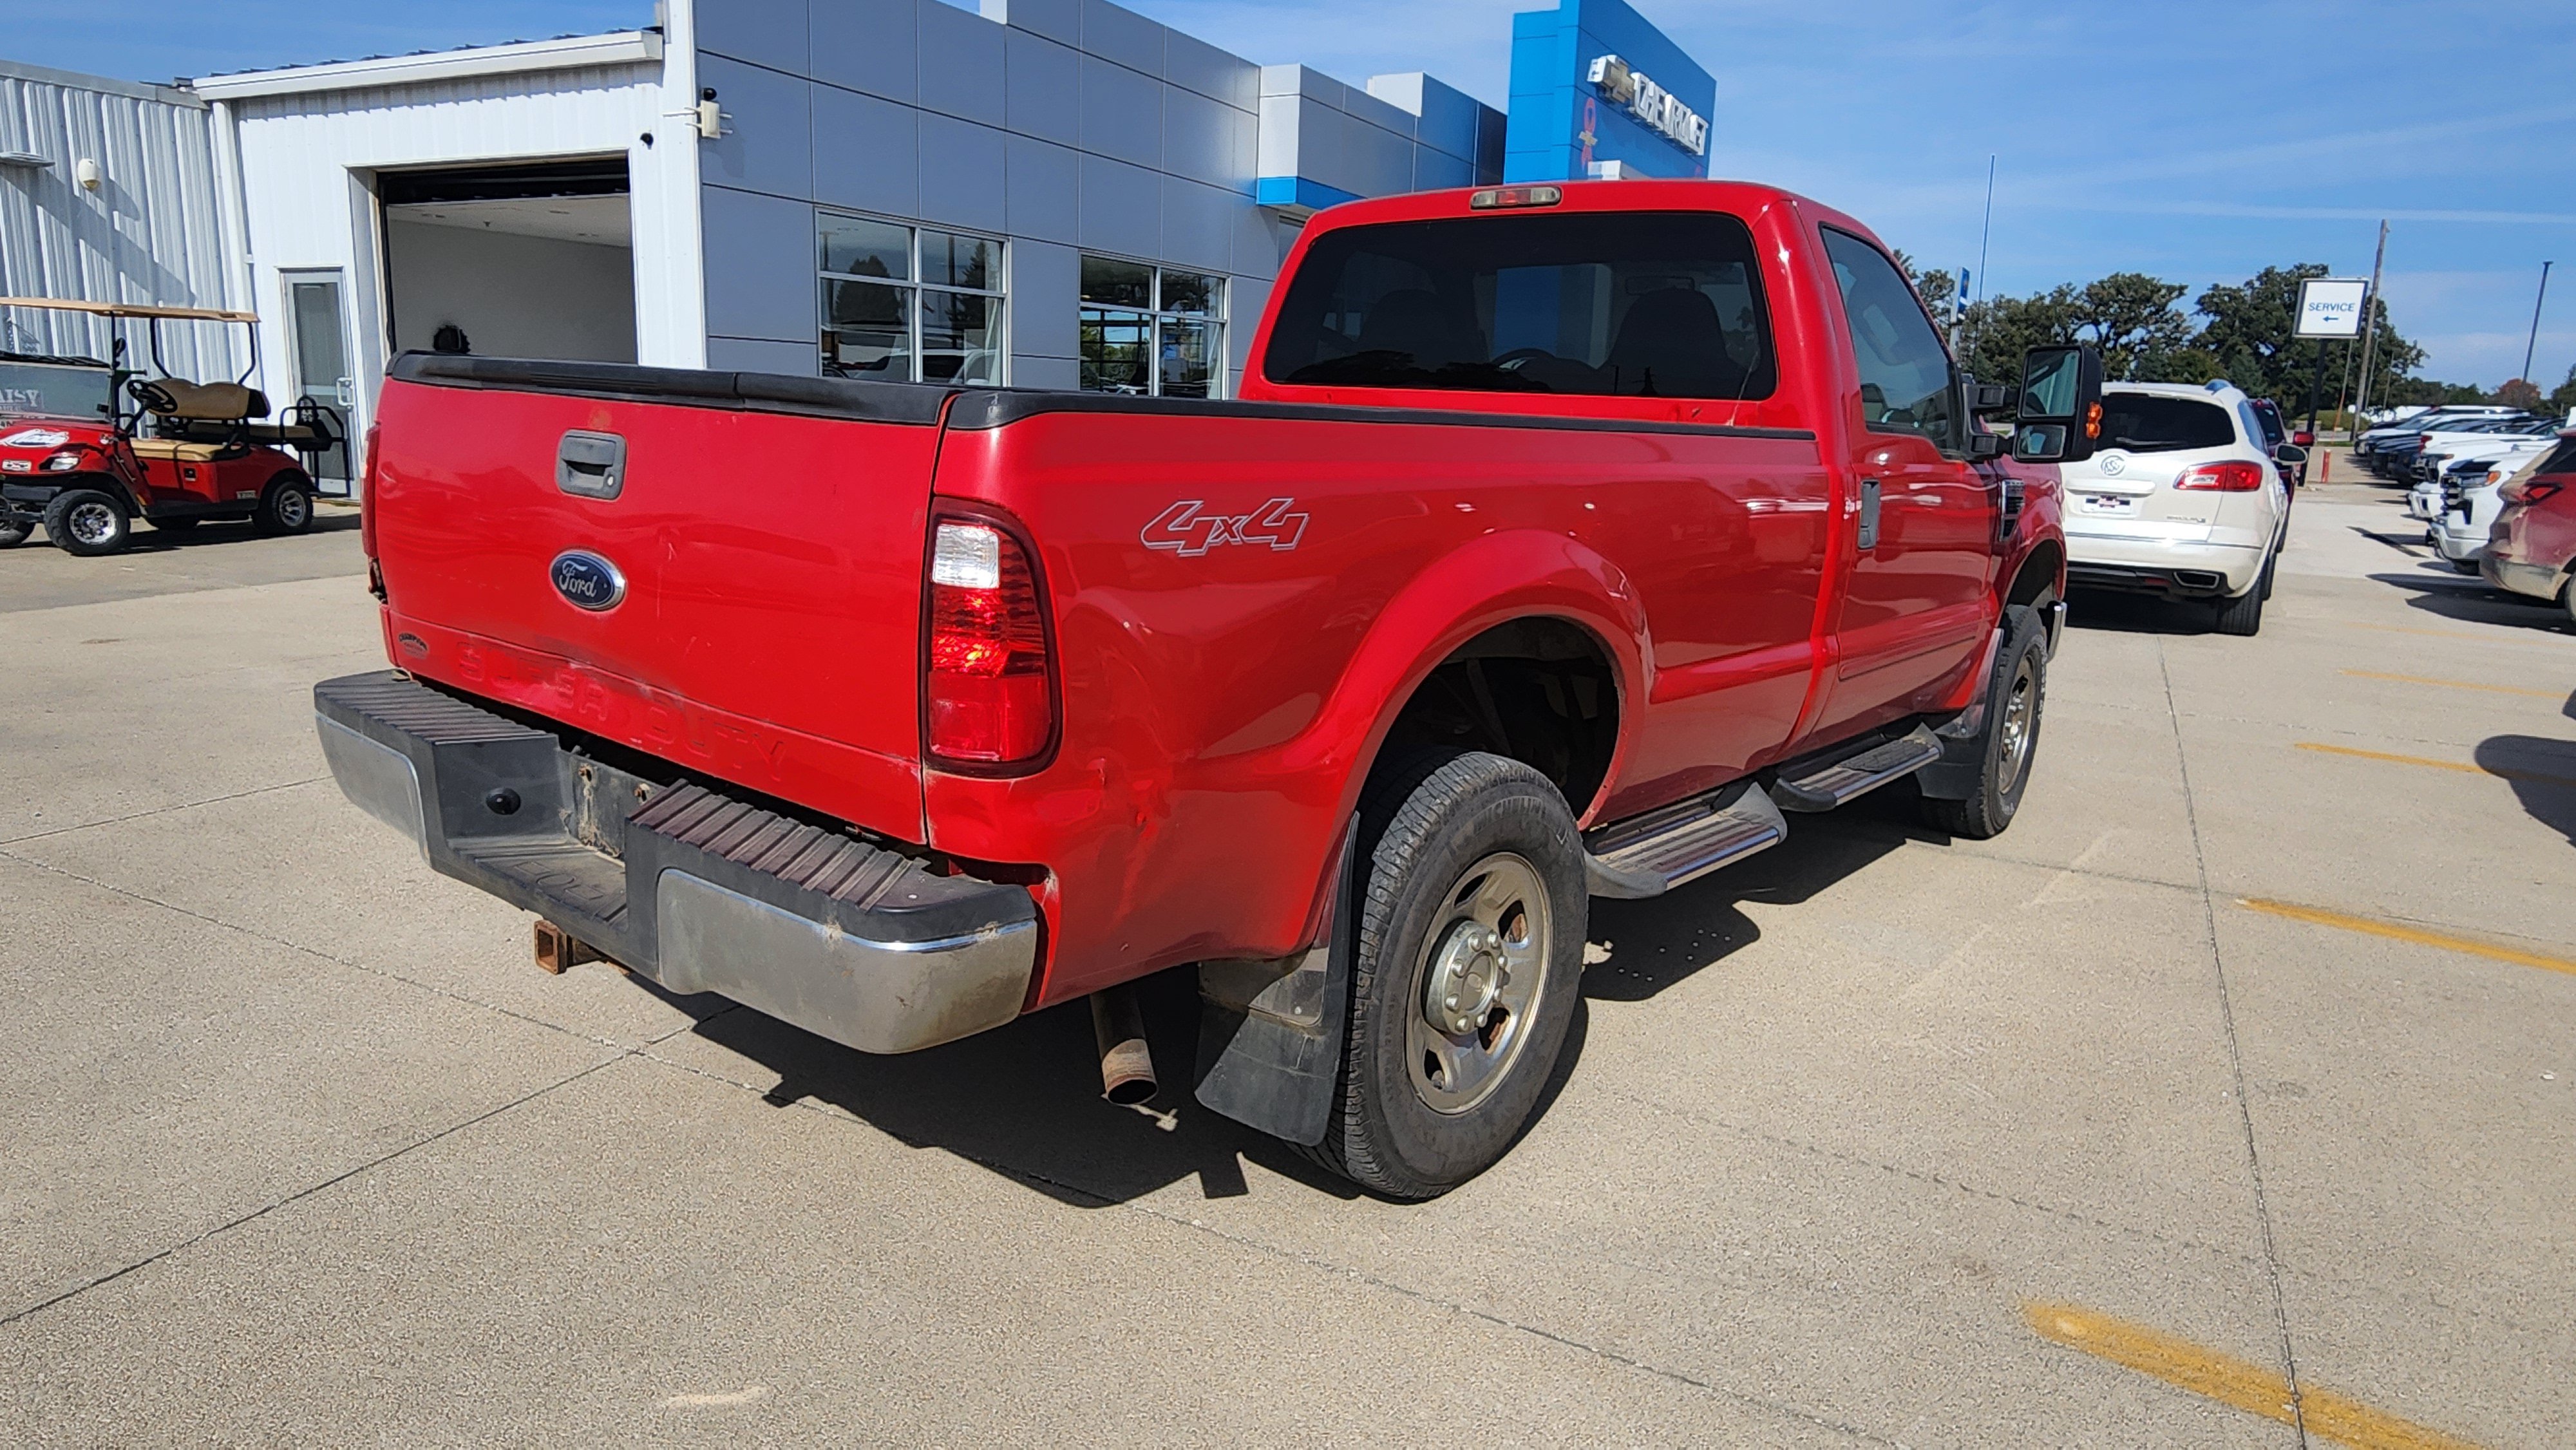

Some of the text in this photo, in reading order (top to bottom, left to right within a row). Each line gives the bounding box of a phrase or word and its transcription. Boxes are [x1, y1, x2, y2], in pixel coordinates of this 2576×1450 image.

[2307, 302, 2355, 312] SERVICE
[1140, 497, 1310, 557] 4x4
[558, 560, 598, 598] Ford
